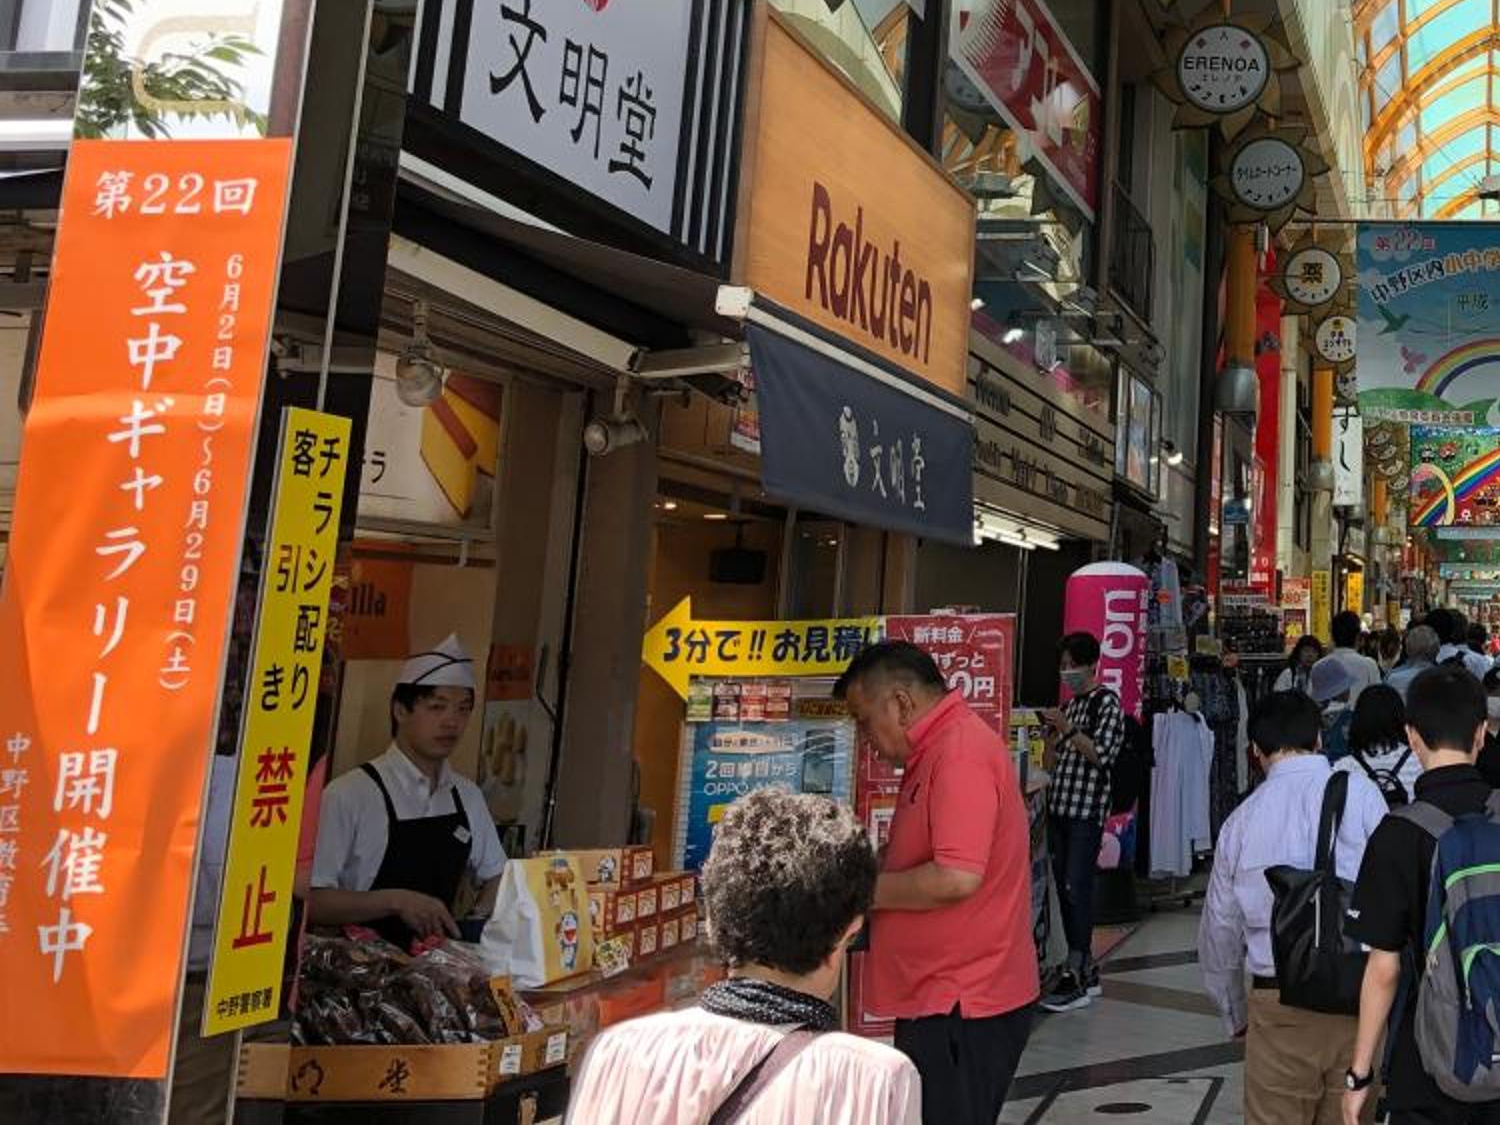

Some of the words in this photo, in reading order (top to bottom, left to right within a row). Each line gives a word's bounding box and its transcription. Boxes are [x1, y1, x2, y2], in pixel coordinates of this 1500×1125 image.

[90, 169, 260, 220] 第22回
[805, 180, 934, 365] Rakuten
[37, 250, 197, 984] 空中ギャラリー開催中
[260, 430, 317, 712] 客引き
[292, 432, 342, 711] チラシ配り
[913, 626, 964, 644] 新料金
[1100, 589, 1137, 659] UQ
[232, 746, 297, 951] 禁止
[703, 781, 750, 796] OPPO
